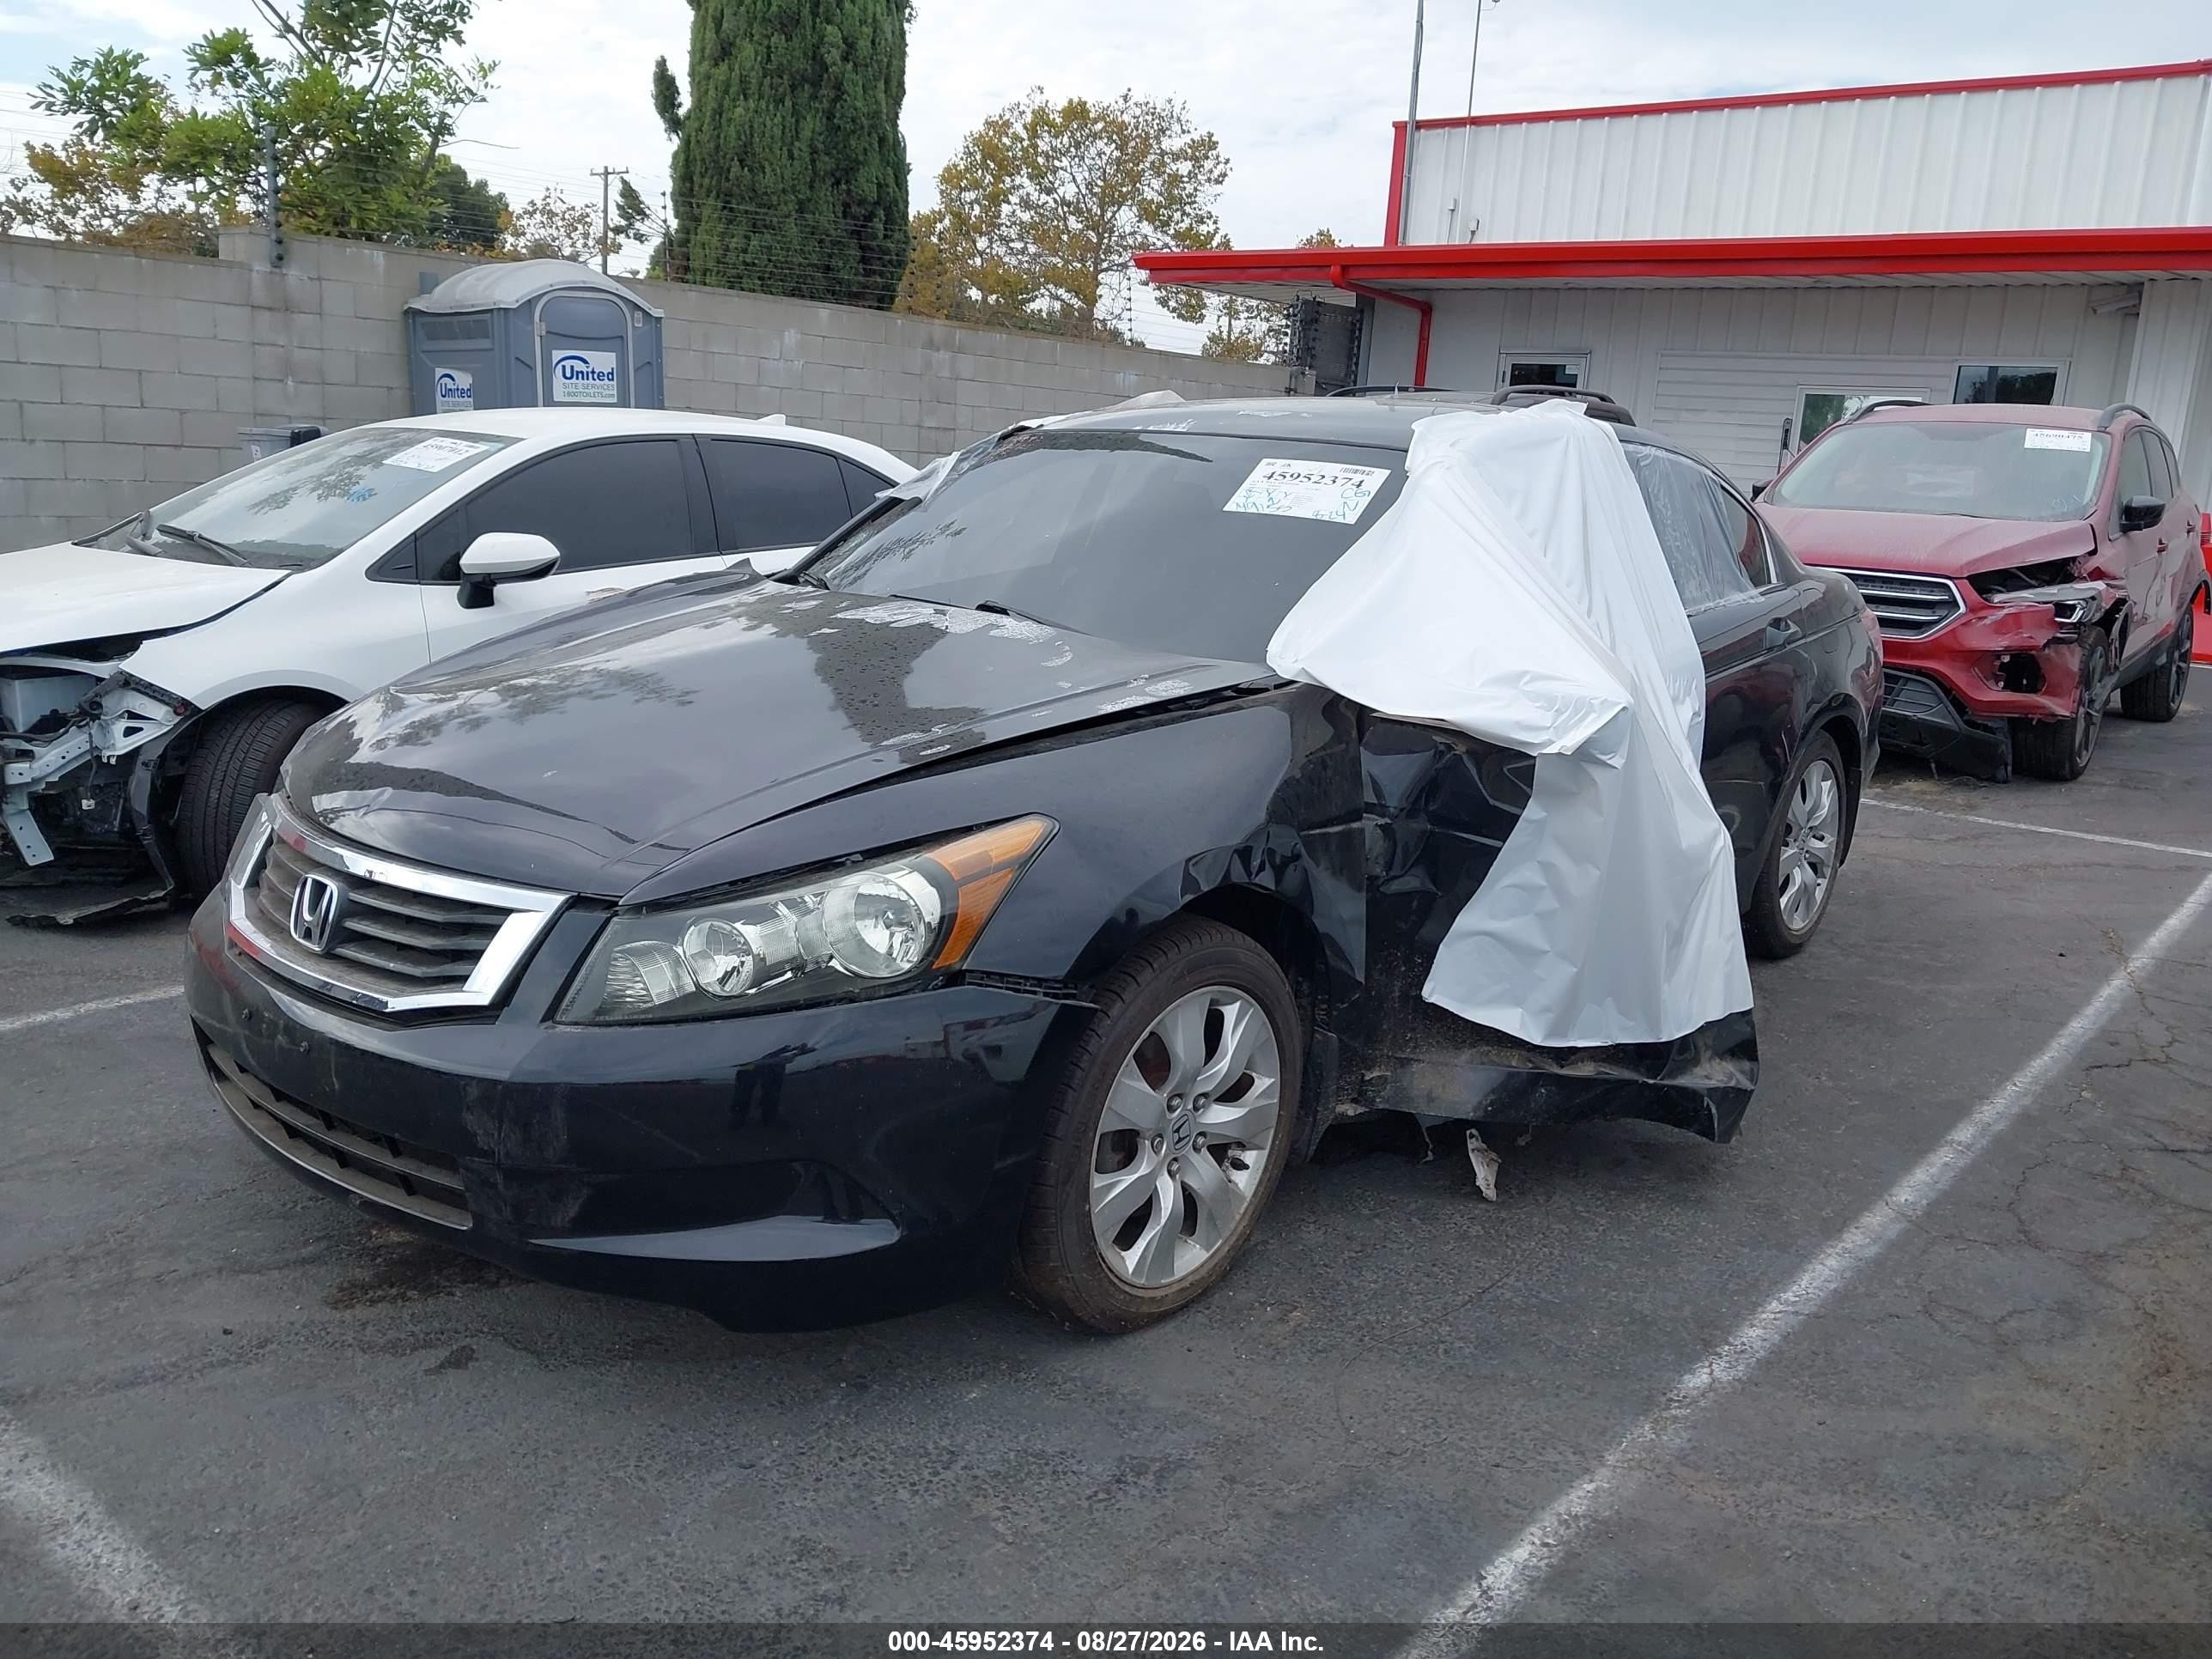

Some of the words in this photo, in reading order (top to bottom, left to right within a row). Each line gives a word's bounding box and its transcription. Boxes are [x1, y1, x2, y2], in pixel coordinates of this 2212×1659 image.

[562, 365, 615, 382] United
[440, 382, 472, 398] United
[1262, 471, 1364, 489] 45952374
